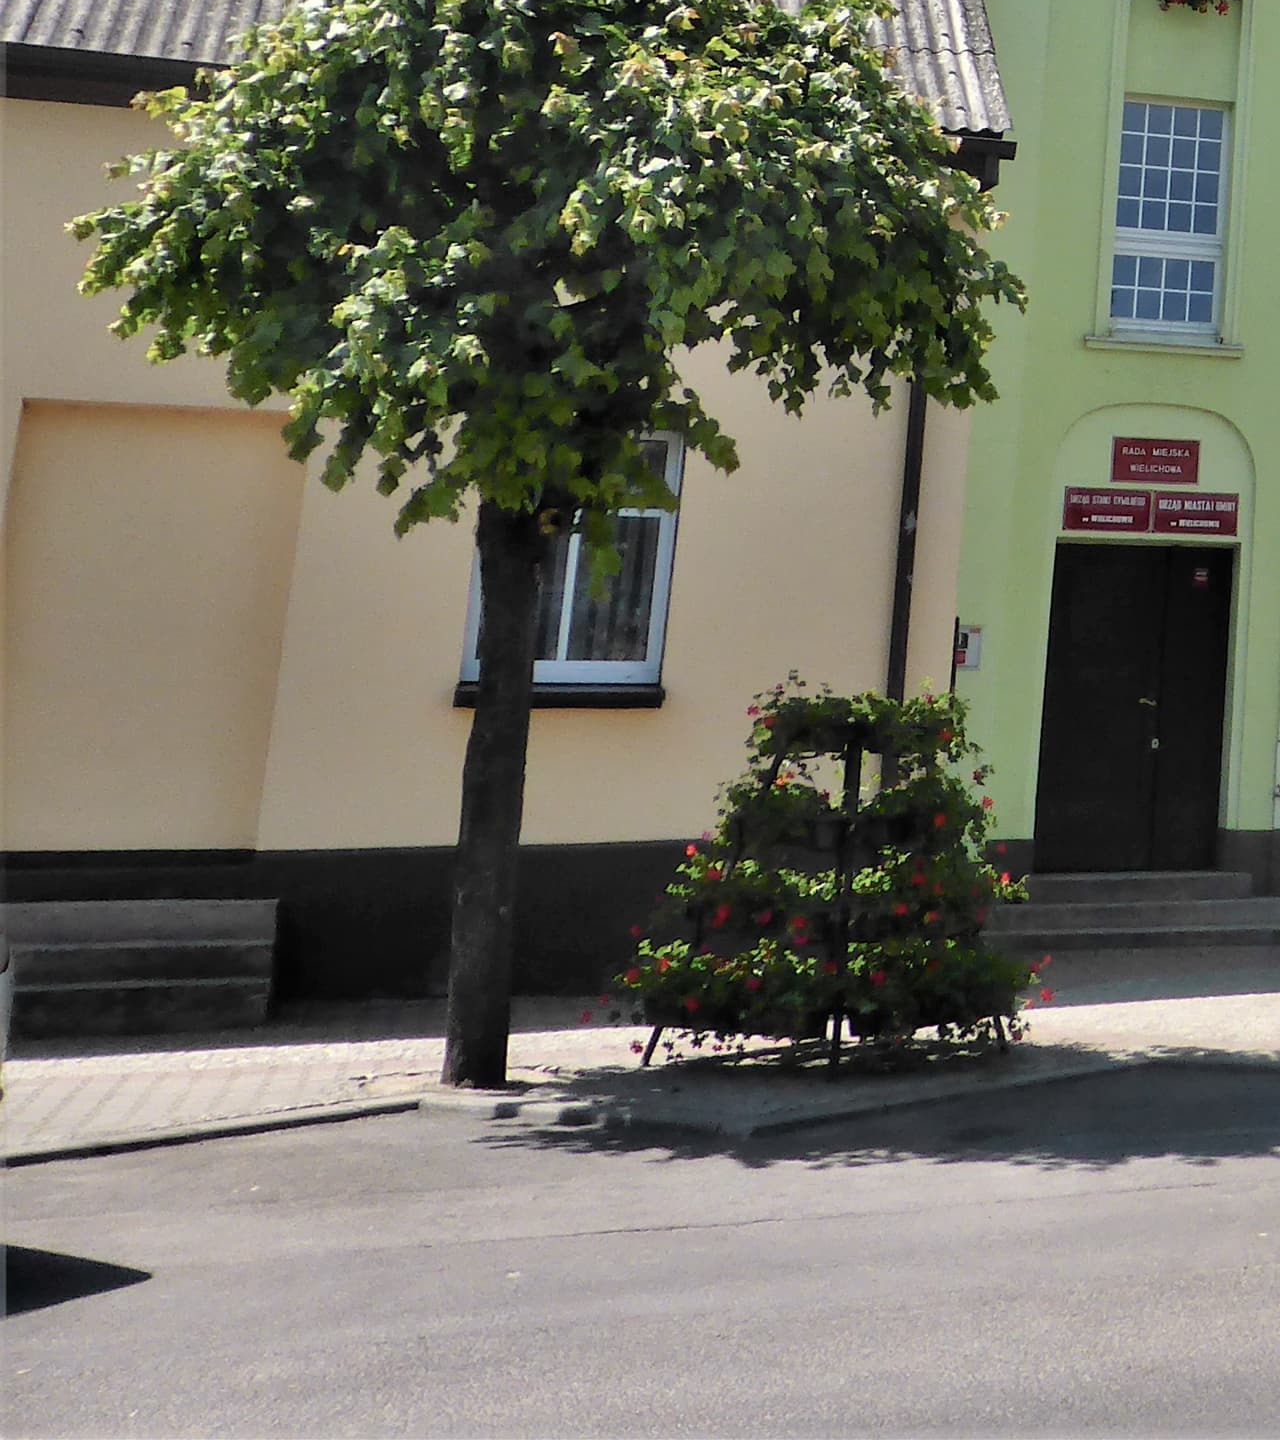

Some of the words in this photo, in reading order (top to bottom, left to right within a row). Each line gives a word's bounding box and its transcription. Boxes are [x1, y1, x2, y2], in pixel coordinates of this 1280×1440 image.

[1122, 446, 1146, 456] RADA
[1152, 448, 1190, 457] MIEJSKA
[1130, 463, 1182, 474] WIELICHOWA
[1184, 500, 1210, 511] MIASTA
